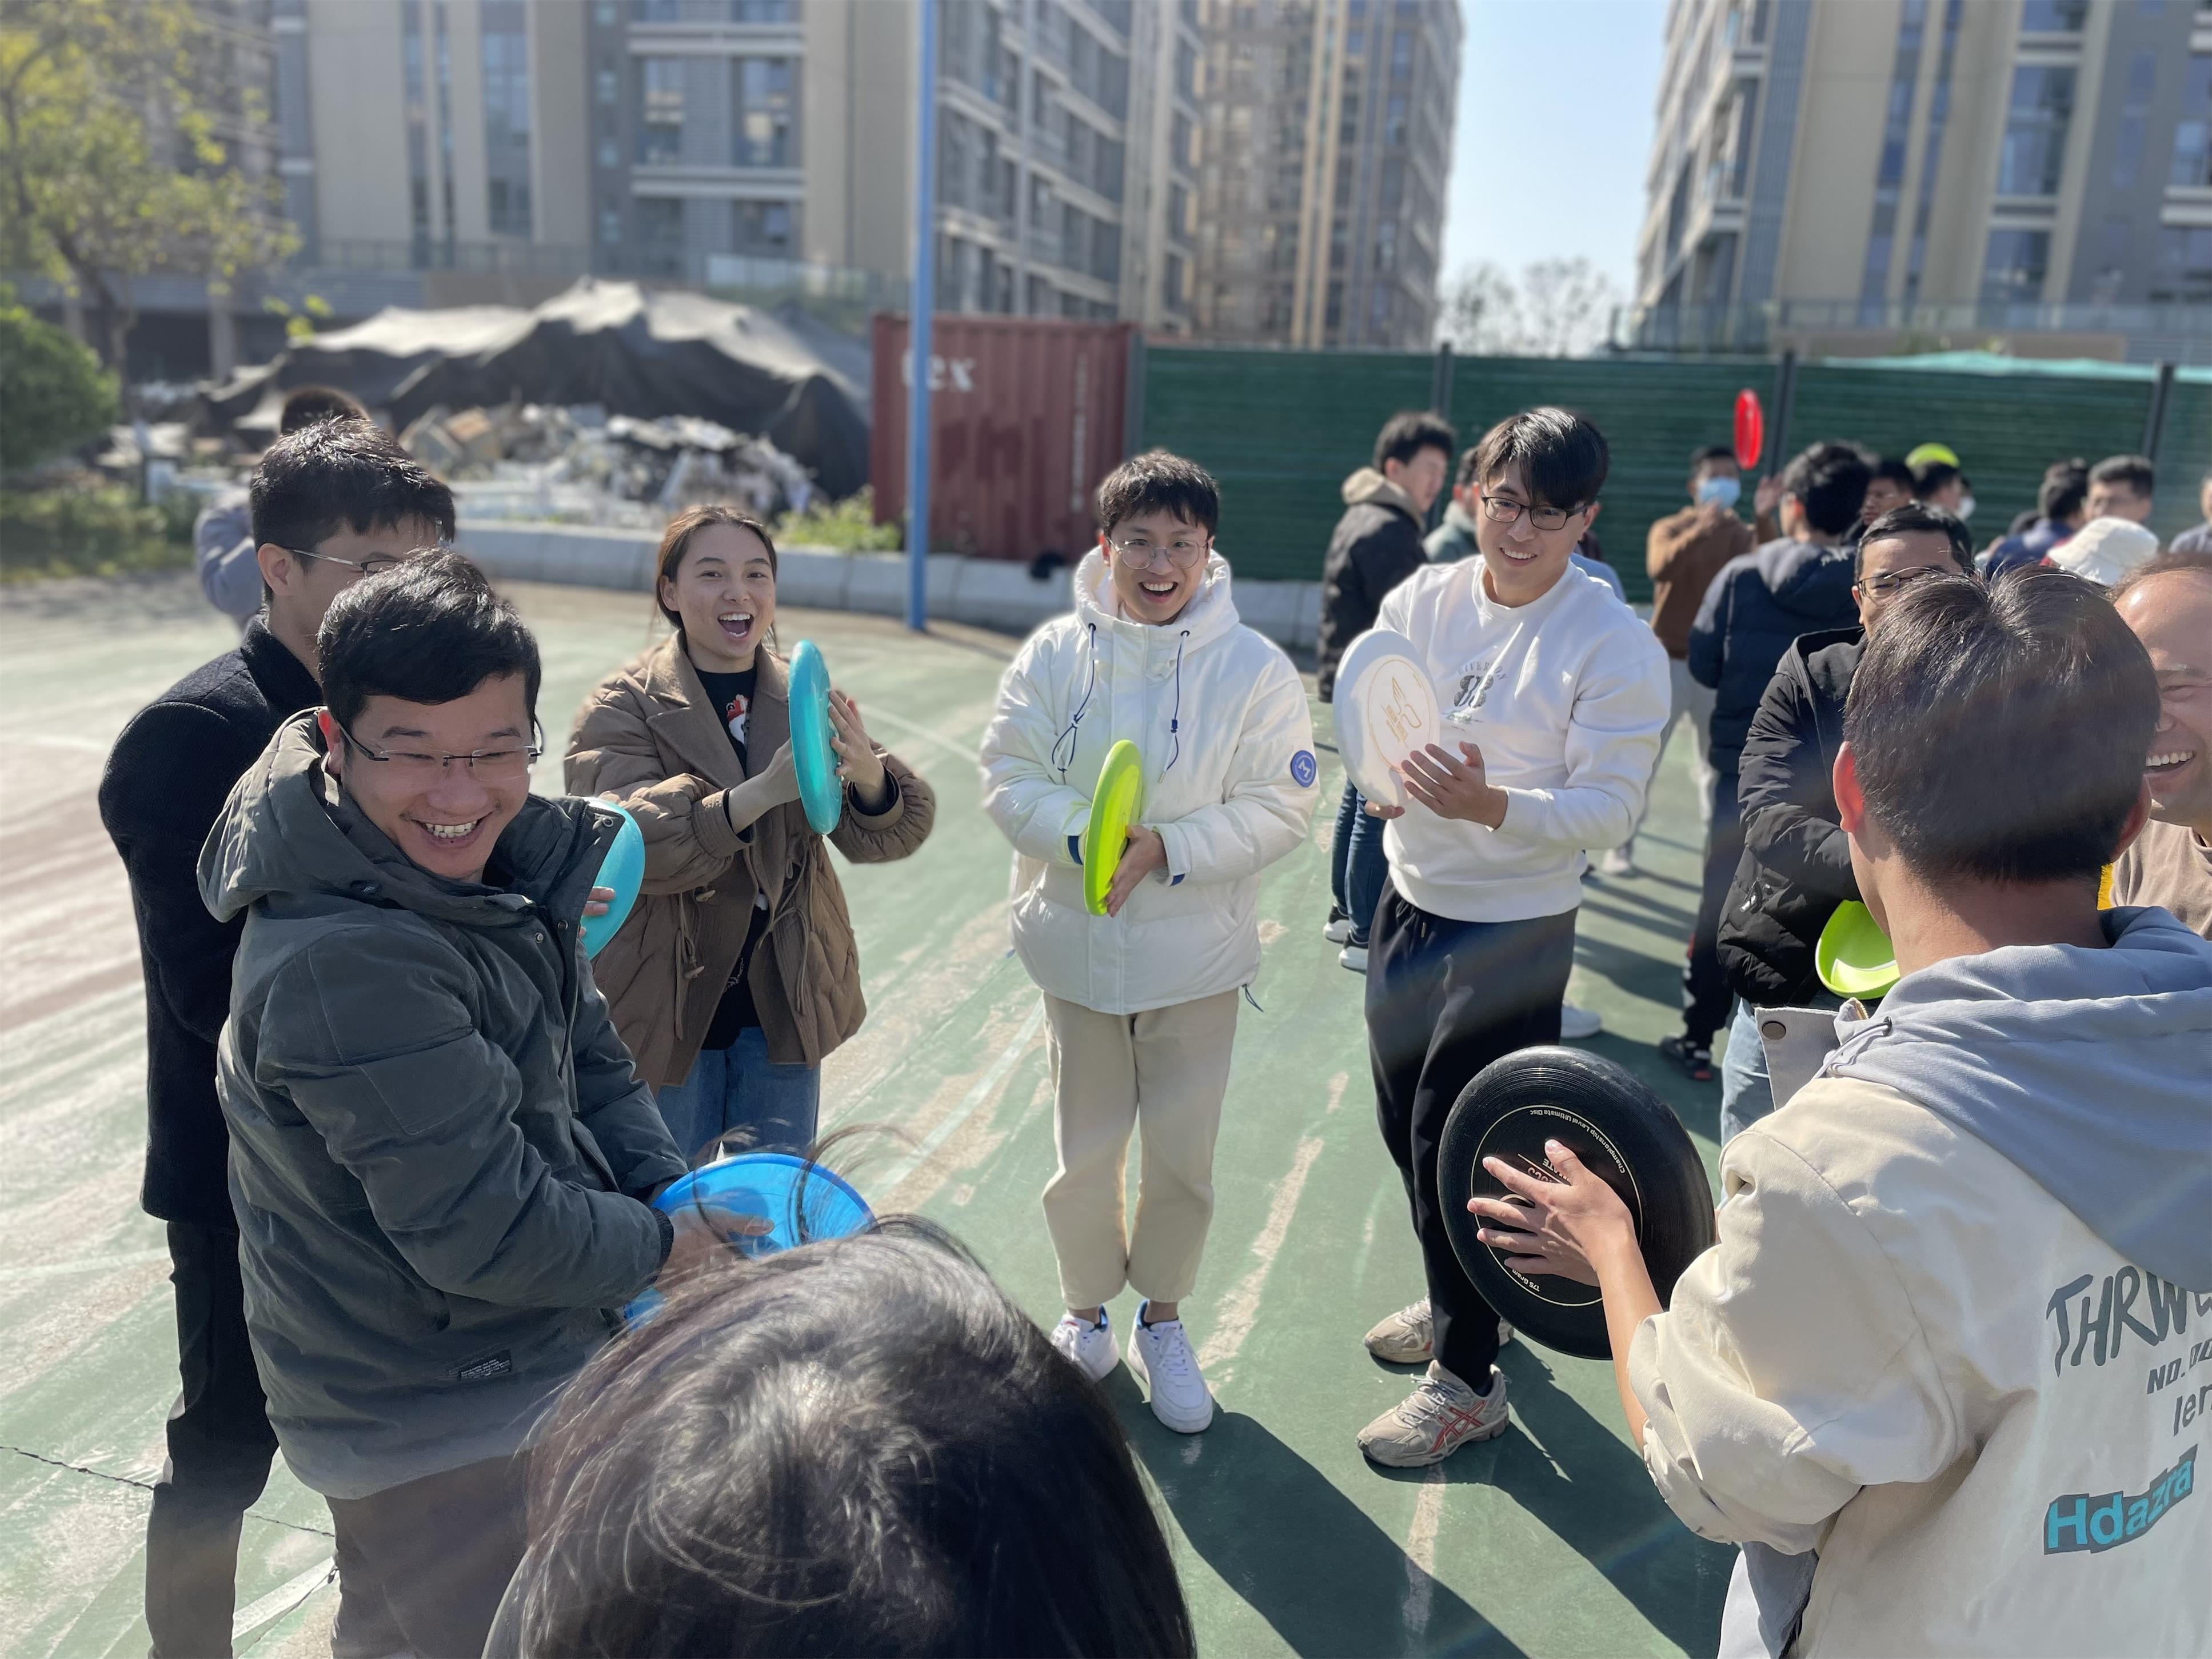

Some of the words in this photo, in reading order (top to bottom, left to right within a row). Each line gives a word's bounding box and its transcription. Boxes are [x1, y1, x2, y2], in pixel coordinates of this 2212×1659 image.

[1590, 1129, 1625, 1173] Championship
[1512, 1269, 1529, 1285] Gram
[1529, 1281, 1540, 1292] 175
